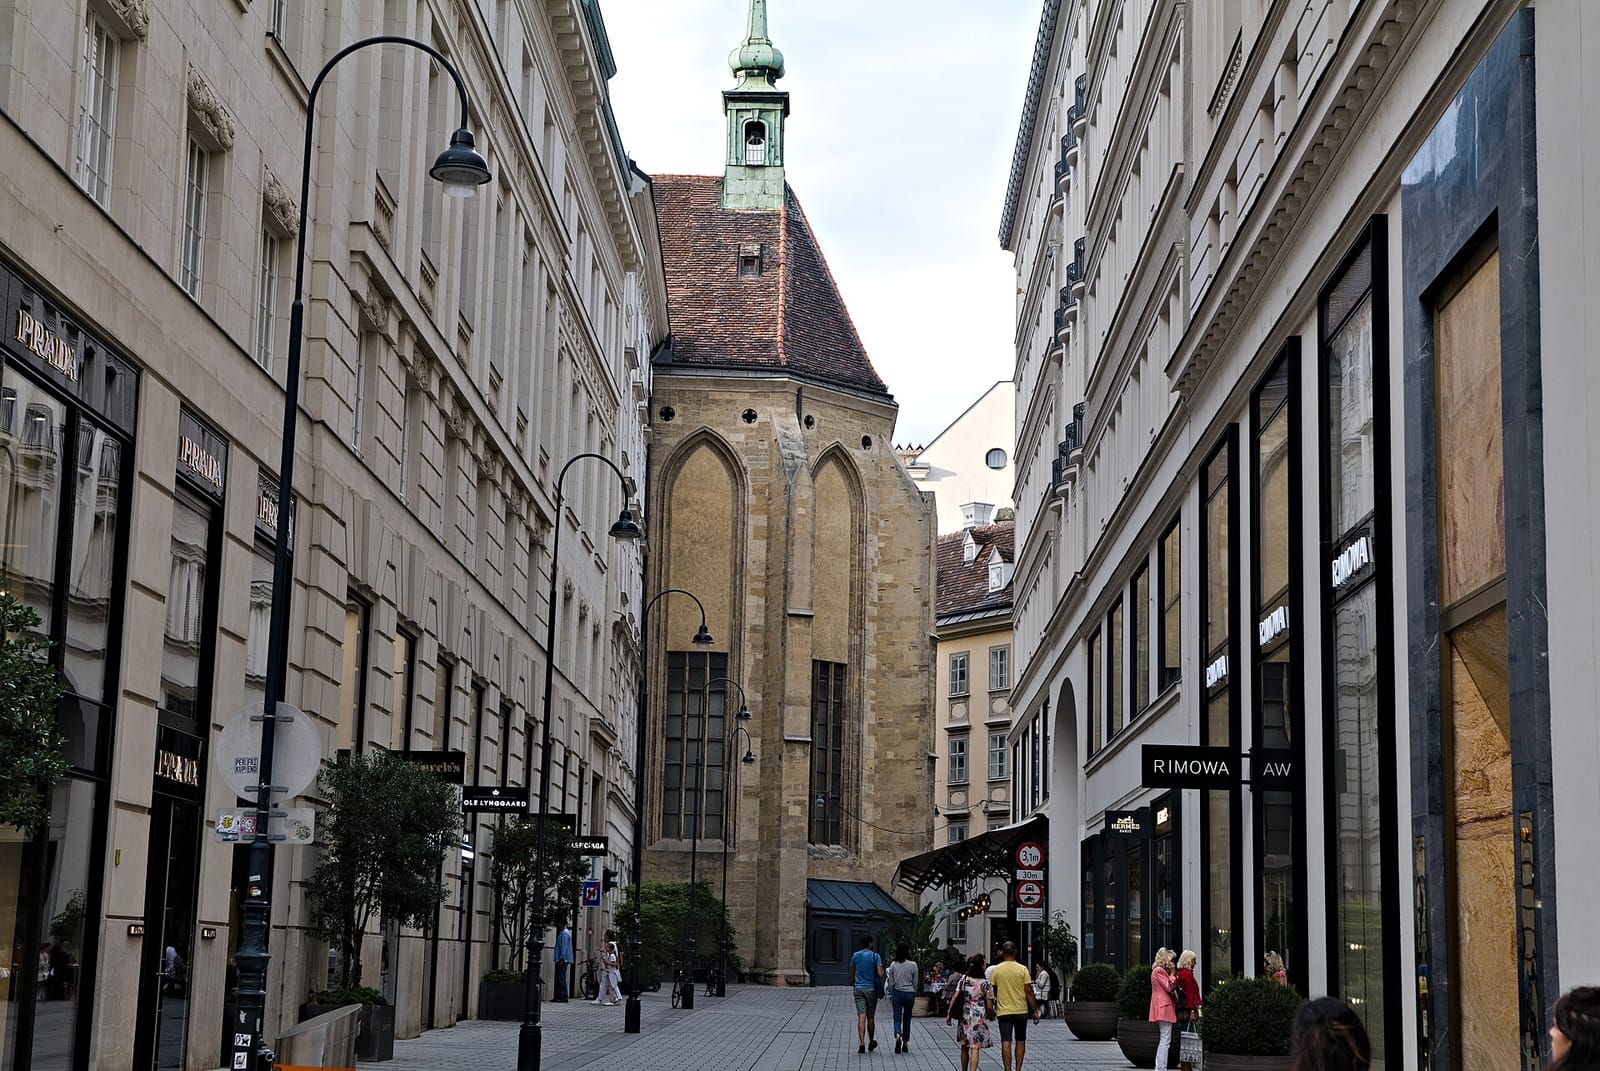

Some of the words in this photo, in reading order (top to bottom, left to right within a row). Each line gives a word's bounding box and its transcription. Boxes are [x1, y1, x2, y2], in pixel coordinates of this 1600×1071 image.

[14, 309, 78, 383] PRADA
[178, 435, 222, 488] PRADA
[1332, 536, 1369, 588] RIMOWA
[1154, 759, 1230, 775] RIMOWA
[1022, 850, 1039, 862] 3,1m
[1022, 871, 1038, 879] 30m
